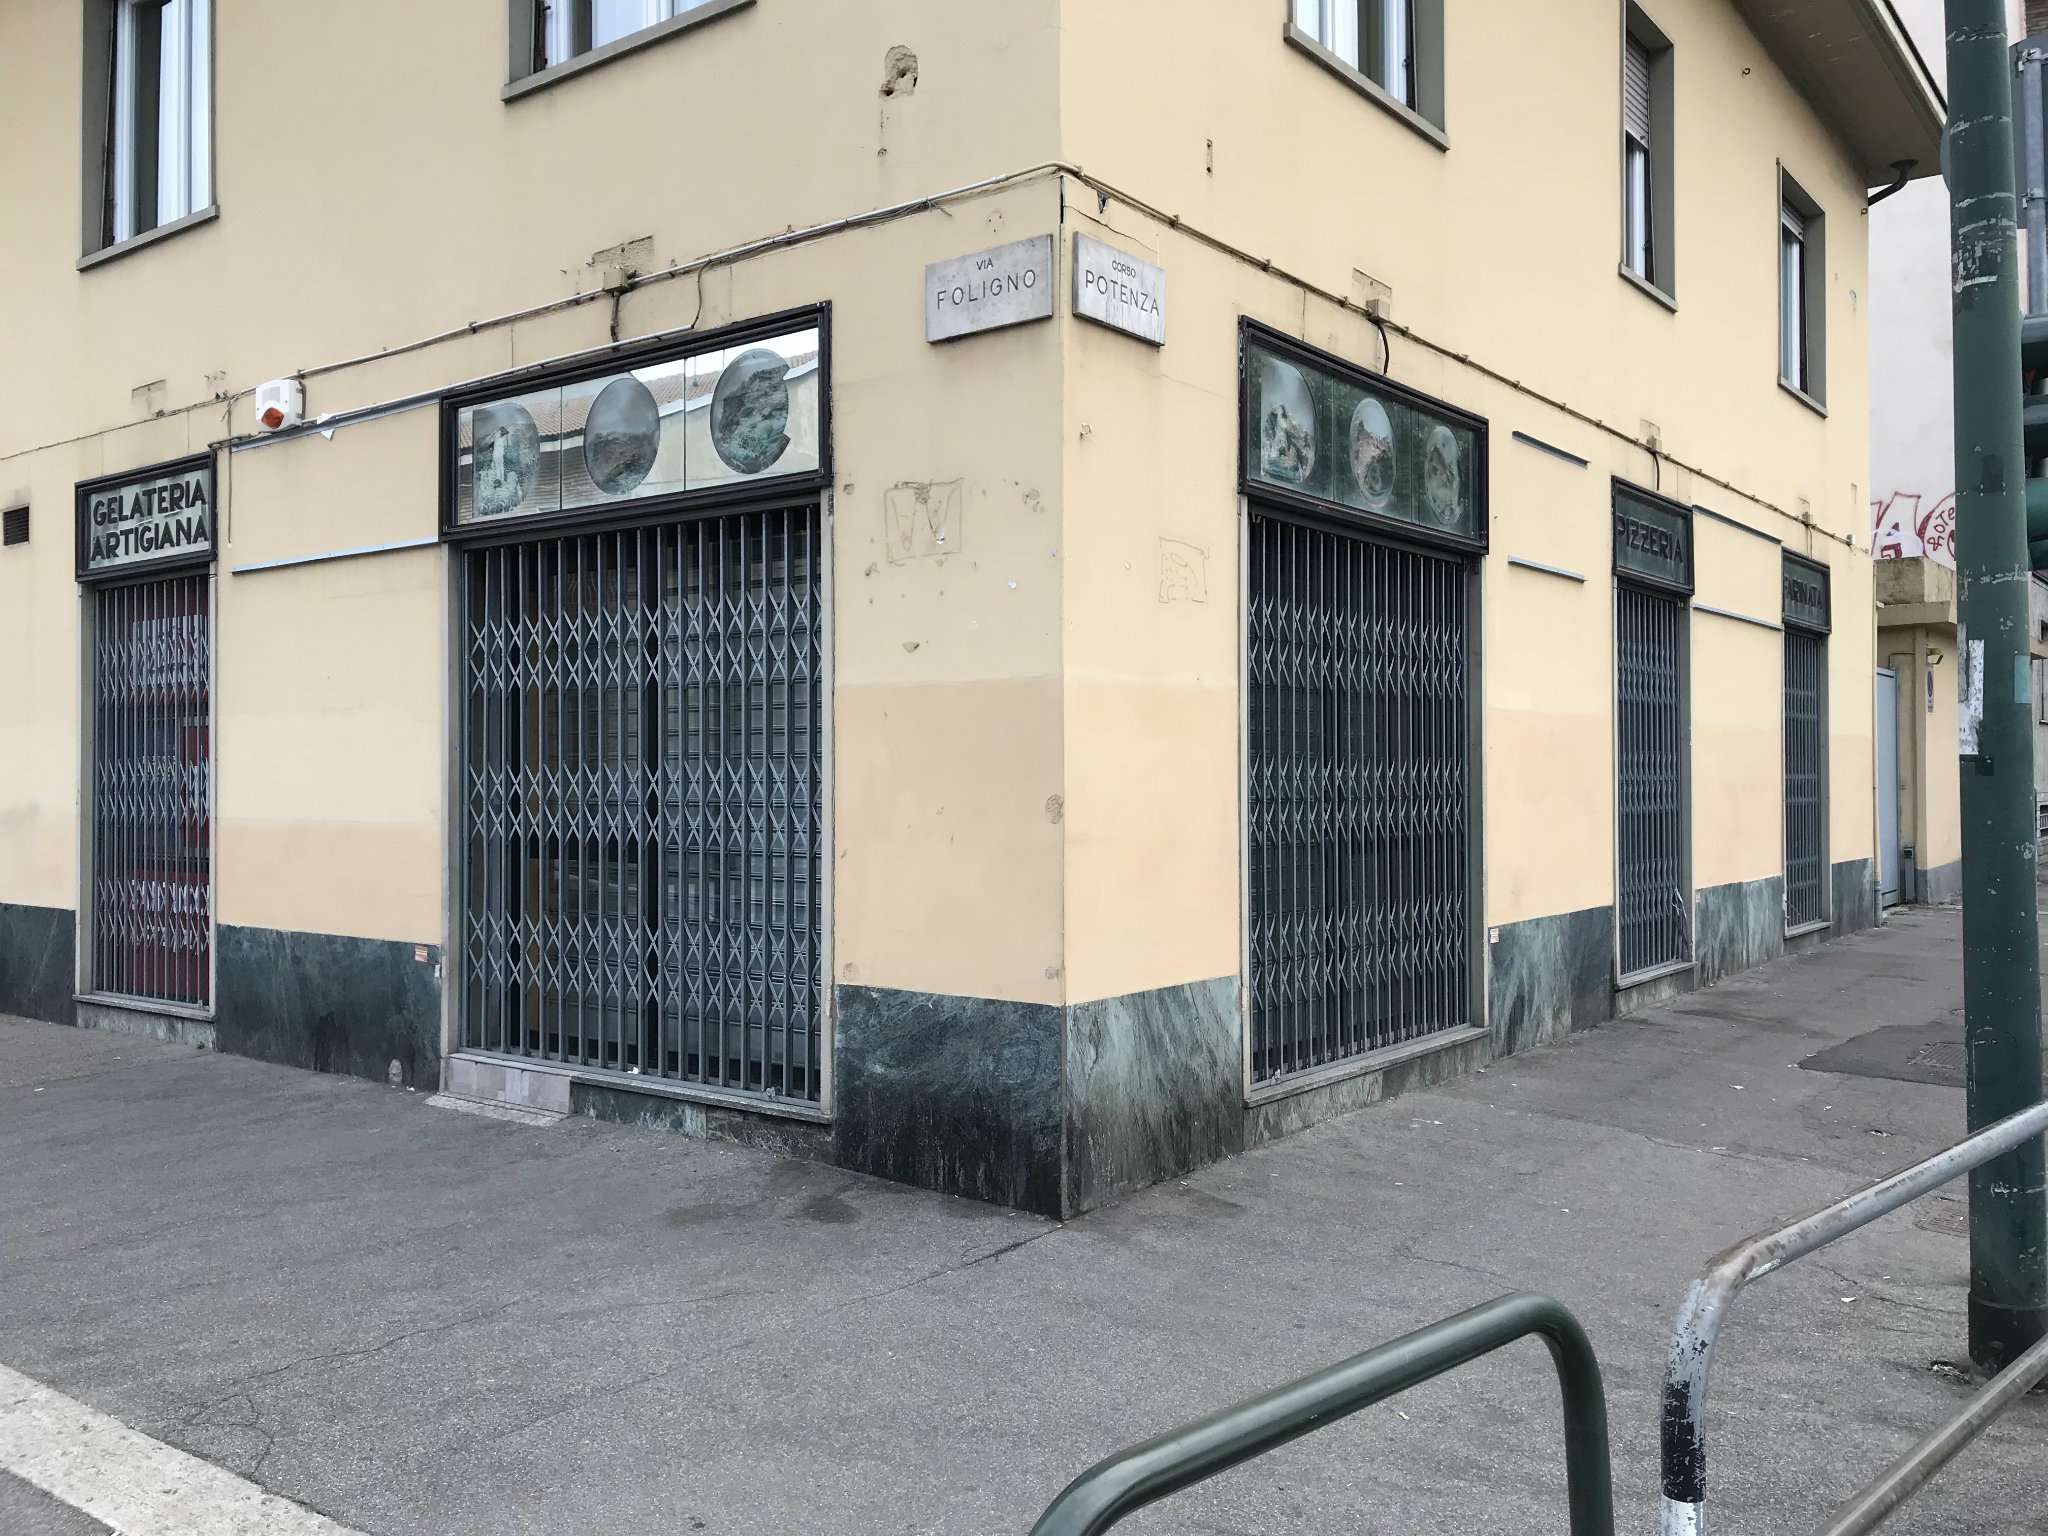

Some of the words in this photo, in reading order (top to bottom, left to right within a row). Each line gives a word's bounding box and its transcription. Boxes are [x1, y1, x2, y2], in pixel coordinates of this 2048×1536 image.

[976, 256, 994, 270] VIA
[1111, 259, 1136, 278] CORSO
[936, 269, 1037, 310] FOLIGNO
[1085, 269, 1160, 317] POTENZA
[93, 478, 208, 527] GELATERIA
[90, 515, 209, 562] ARTIGIANA
[1616, 514, 1683, 563] PIZZERIA
